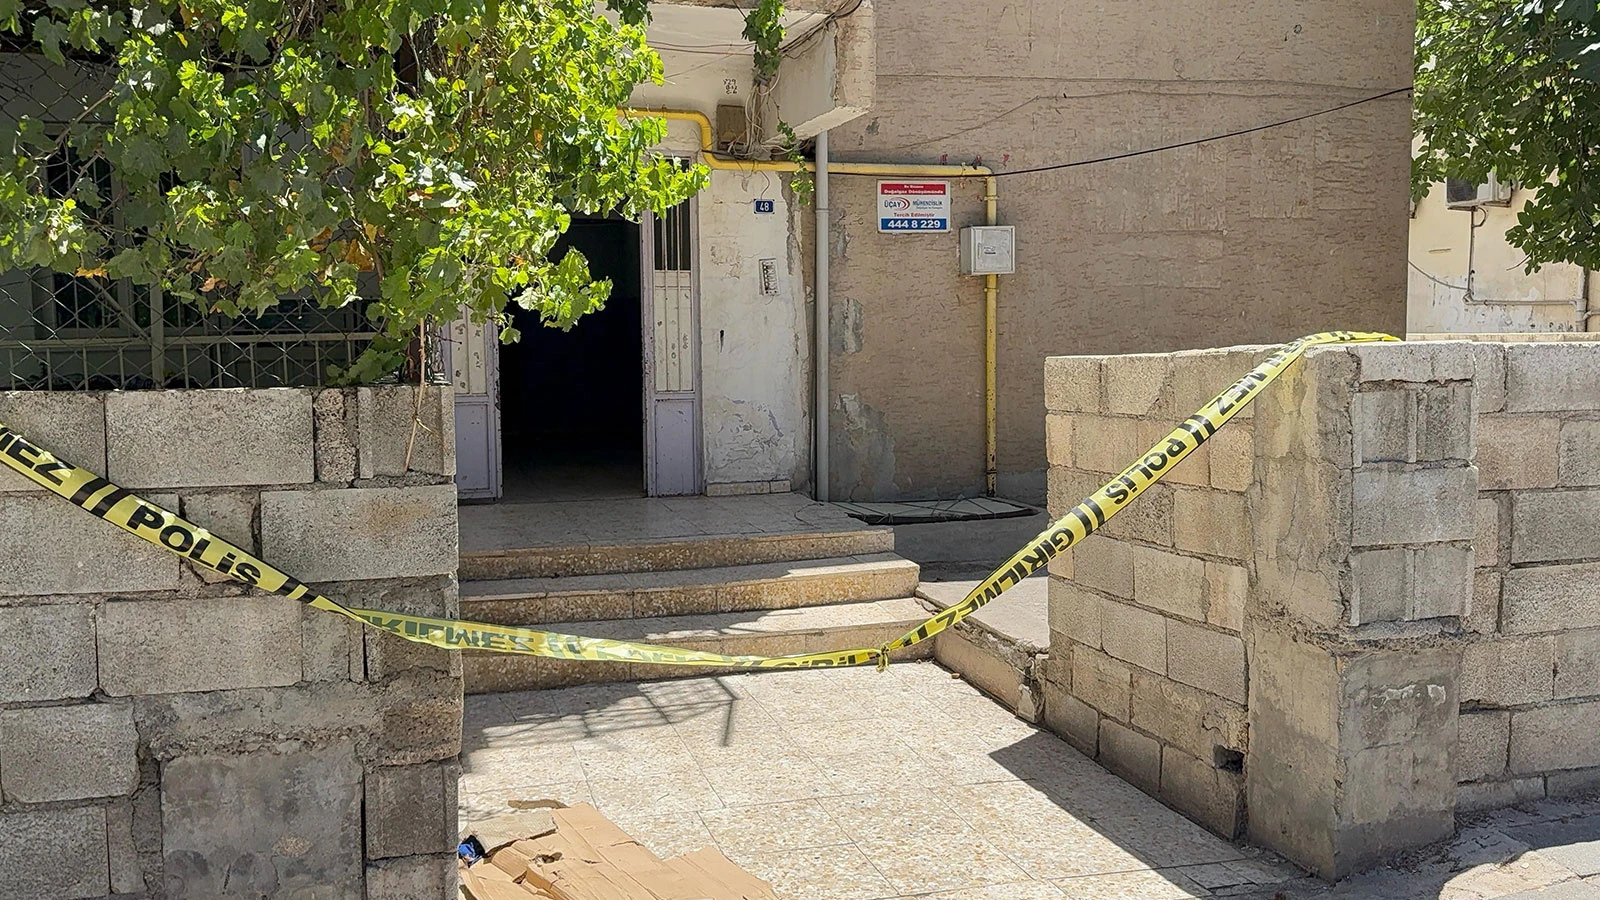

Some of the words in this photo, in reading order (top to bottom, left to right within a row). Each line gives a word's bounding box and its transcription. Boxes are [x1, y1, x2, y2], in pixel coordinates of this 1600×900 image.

[759, 201, 770, 212] 48
[884, 199, 902, 209] ÜÇAY
[887, 219, 909, 229] 444
[911, 219, 919, 229] 8
[920, 219, 941, 229] 229
